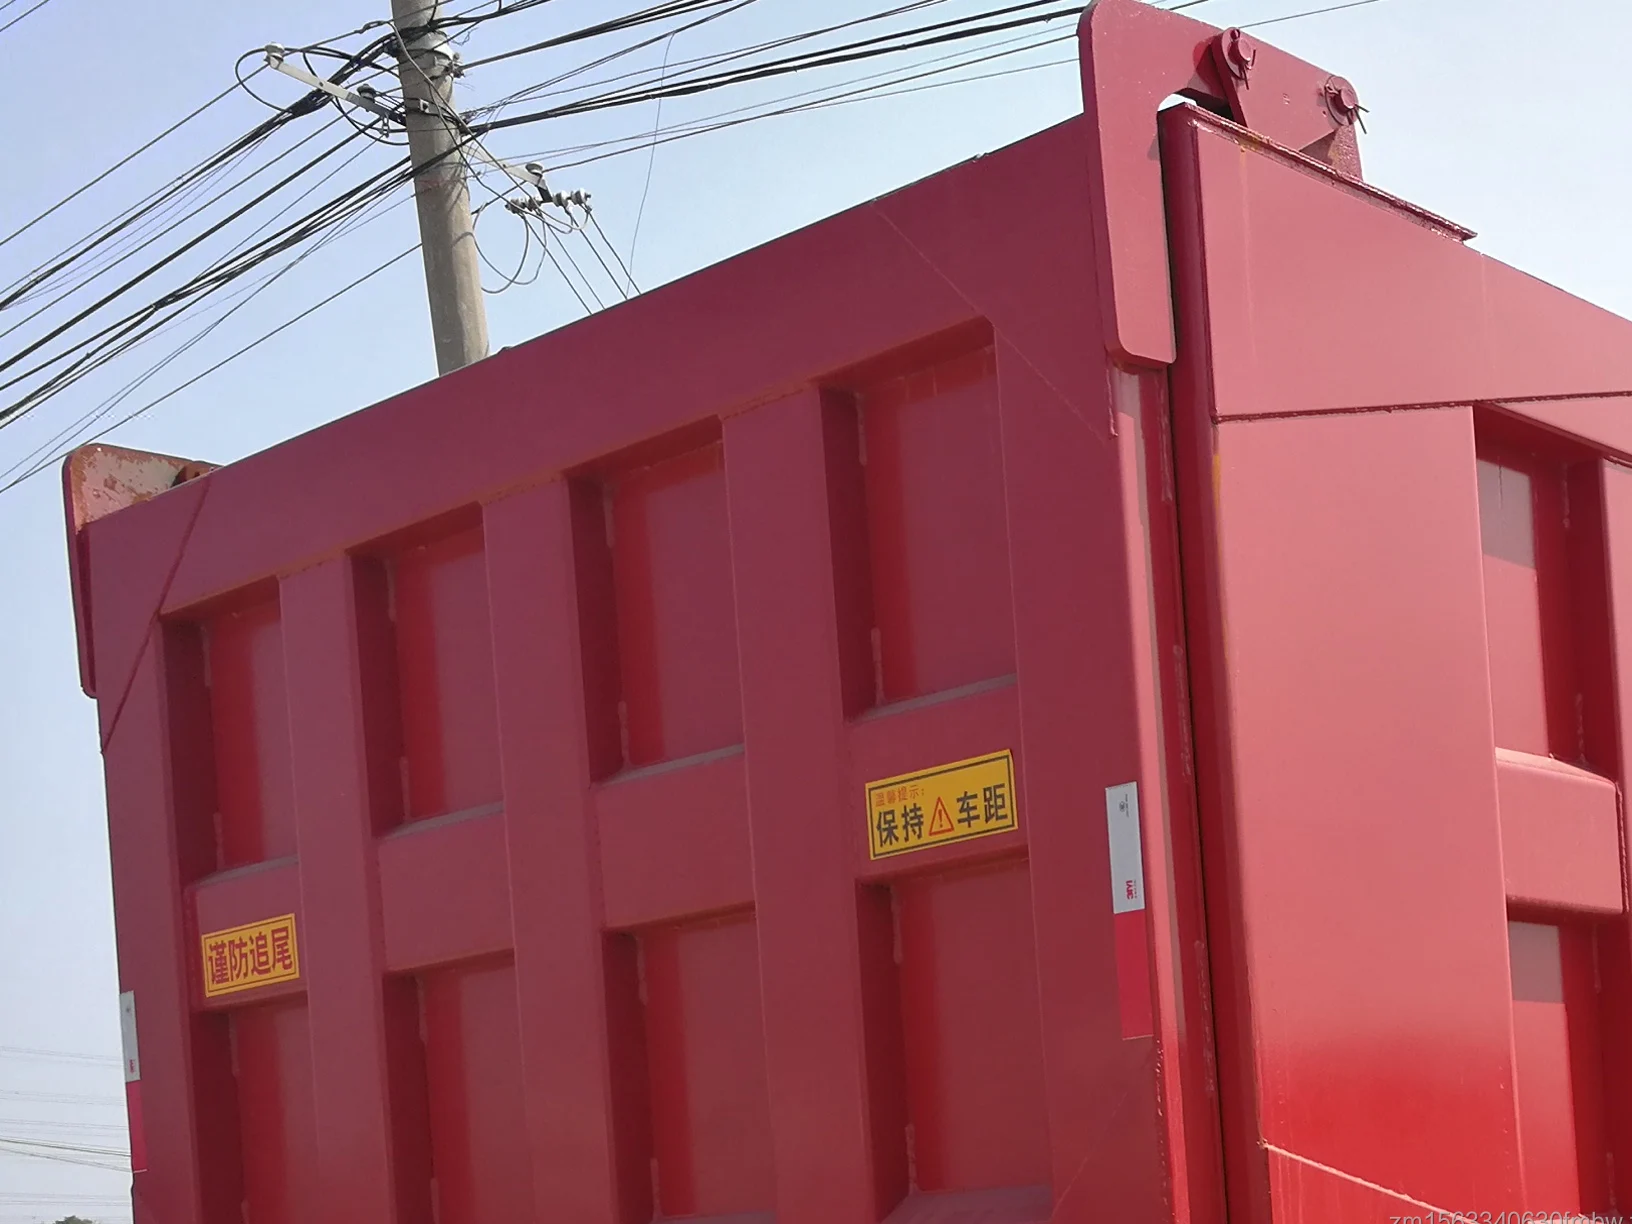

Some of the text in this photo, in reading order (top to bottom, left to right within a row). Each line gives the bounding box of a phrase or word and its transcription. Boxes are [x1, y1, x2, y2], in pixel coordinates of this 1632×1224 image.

[876, 783, 1008, 847] 保持 车距
[208, 926, 293, 985] 谨防追尾
